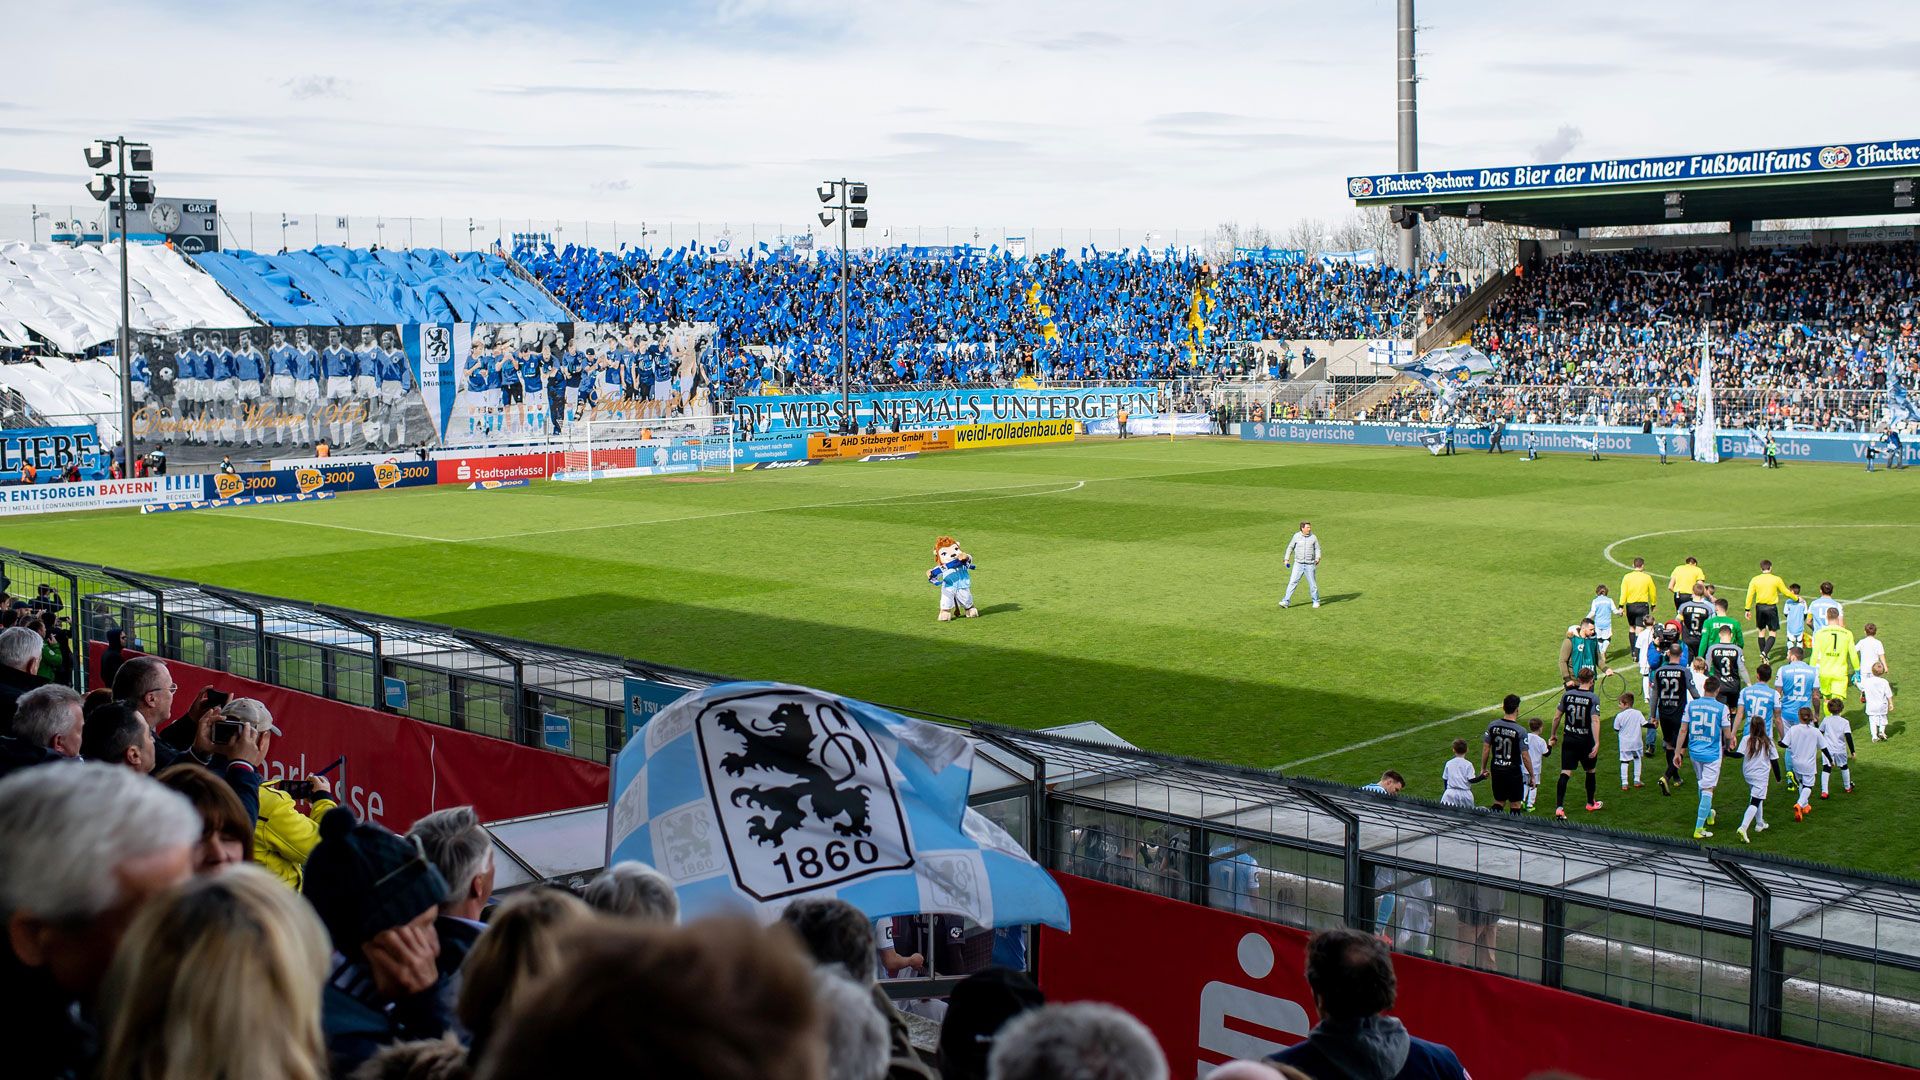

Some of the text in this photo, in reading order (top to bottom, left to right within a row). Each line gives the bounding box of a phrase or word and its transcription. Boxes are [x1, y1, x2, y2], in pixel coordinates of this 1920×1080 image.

[1376, 150, 1812, 194] Hacker-Pschorr Das Bier der Münchner Fußballfans
[188, 204, 211, 213] GAST
[206, 221, 212, 231] 0
[338, 217, 345, 228] H
[313, 399, 369, 426] 1966
[737, 392, 1156, 431] DU WIRST NIEMALS UNTERGEHN
[840, 433, 925, 446] AHD Sitzberger GmbH
[956, 419, 1073, 443] weidl-rolladenbau.de
[1268, 425, 1355, 441] die Bayerische
[1453, 430, 1486, 445] nach
[671, 448, 688, 462] die
[690, 445, 744, 461] Bayerische
[300, 471, 355, 486] Bet 3000
[379, 466, 429, 480] Bet 3000
[474, 465, 544, 479] Stadtsparkasse
[11, 485, 95, 502] ENTSORGEN
[99, 481, 158, 496] BAYERN!
[220, 476, 276, 491] Bet 3000
[12, 504, 40, 512] METALLE
[45, 500, 101, 510] CONTAINERDIENST
[1691, 613, 1700, 631] 5
[1831, 633, 1838, 652] 1
[1720, 656, 1731, 676] 3
[1660, 677, 1680, 699] 22
[1792, 673, 1807, 698] 9
[643, 700, 659, 714] TSV
[1566, 704, 1586, 727] 34
[1743, 694, 1769, 720] 36
[1690, 710, 1717, 737] 24
[1493, 735, 1513, 760] 20
[773, 839, 879, 884] 1860
